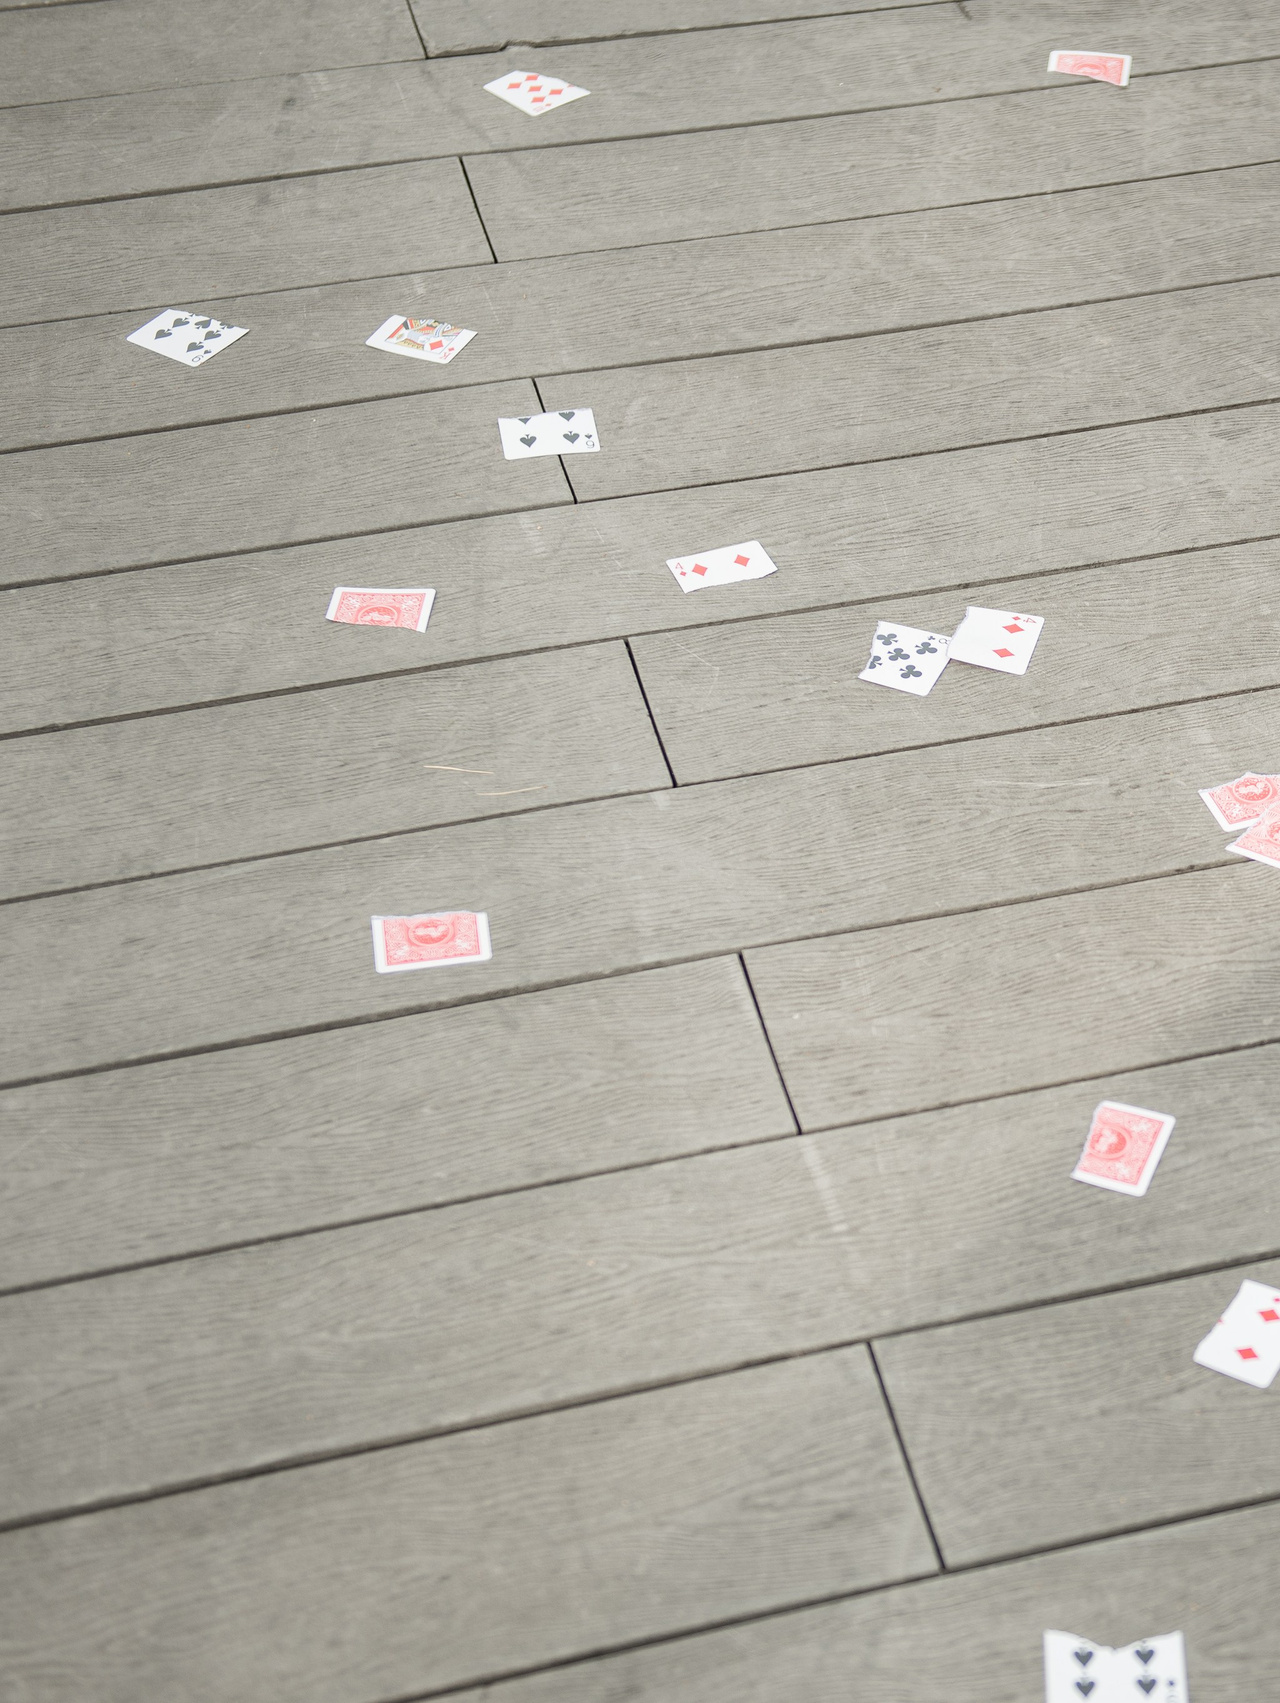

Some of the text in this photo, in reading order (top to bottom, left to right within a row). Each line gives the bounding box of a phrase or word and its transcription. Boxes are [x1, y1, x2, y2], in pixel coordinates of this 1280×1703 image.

[192, 354, 204, 362] 9
[439, 352, 451, 360] K
[585, 439, 595, 449] 6
[675, 562, 684, 570] 7
